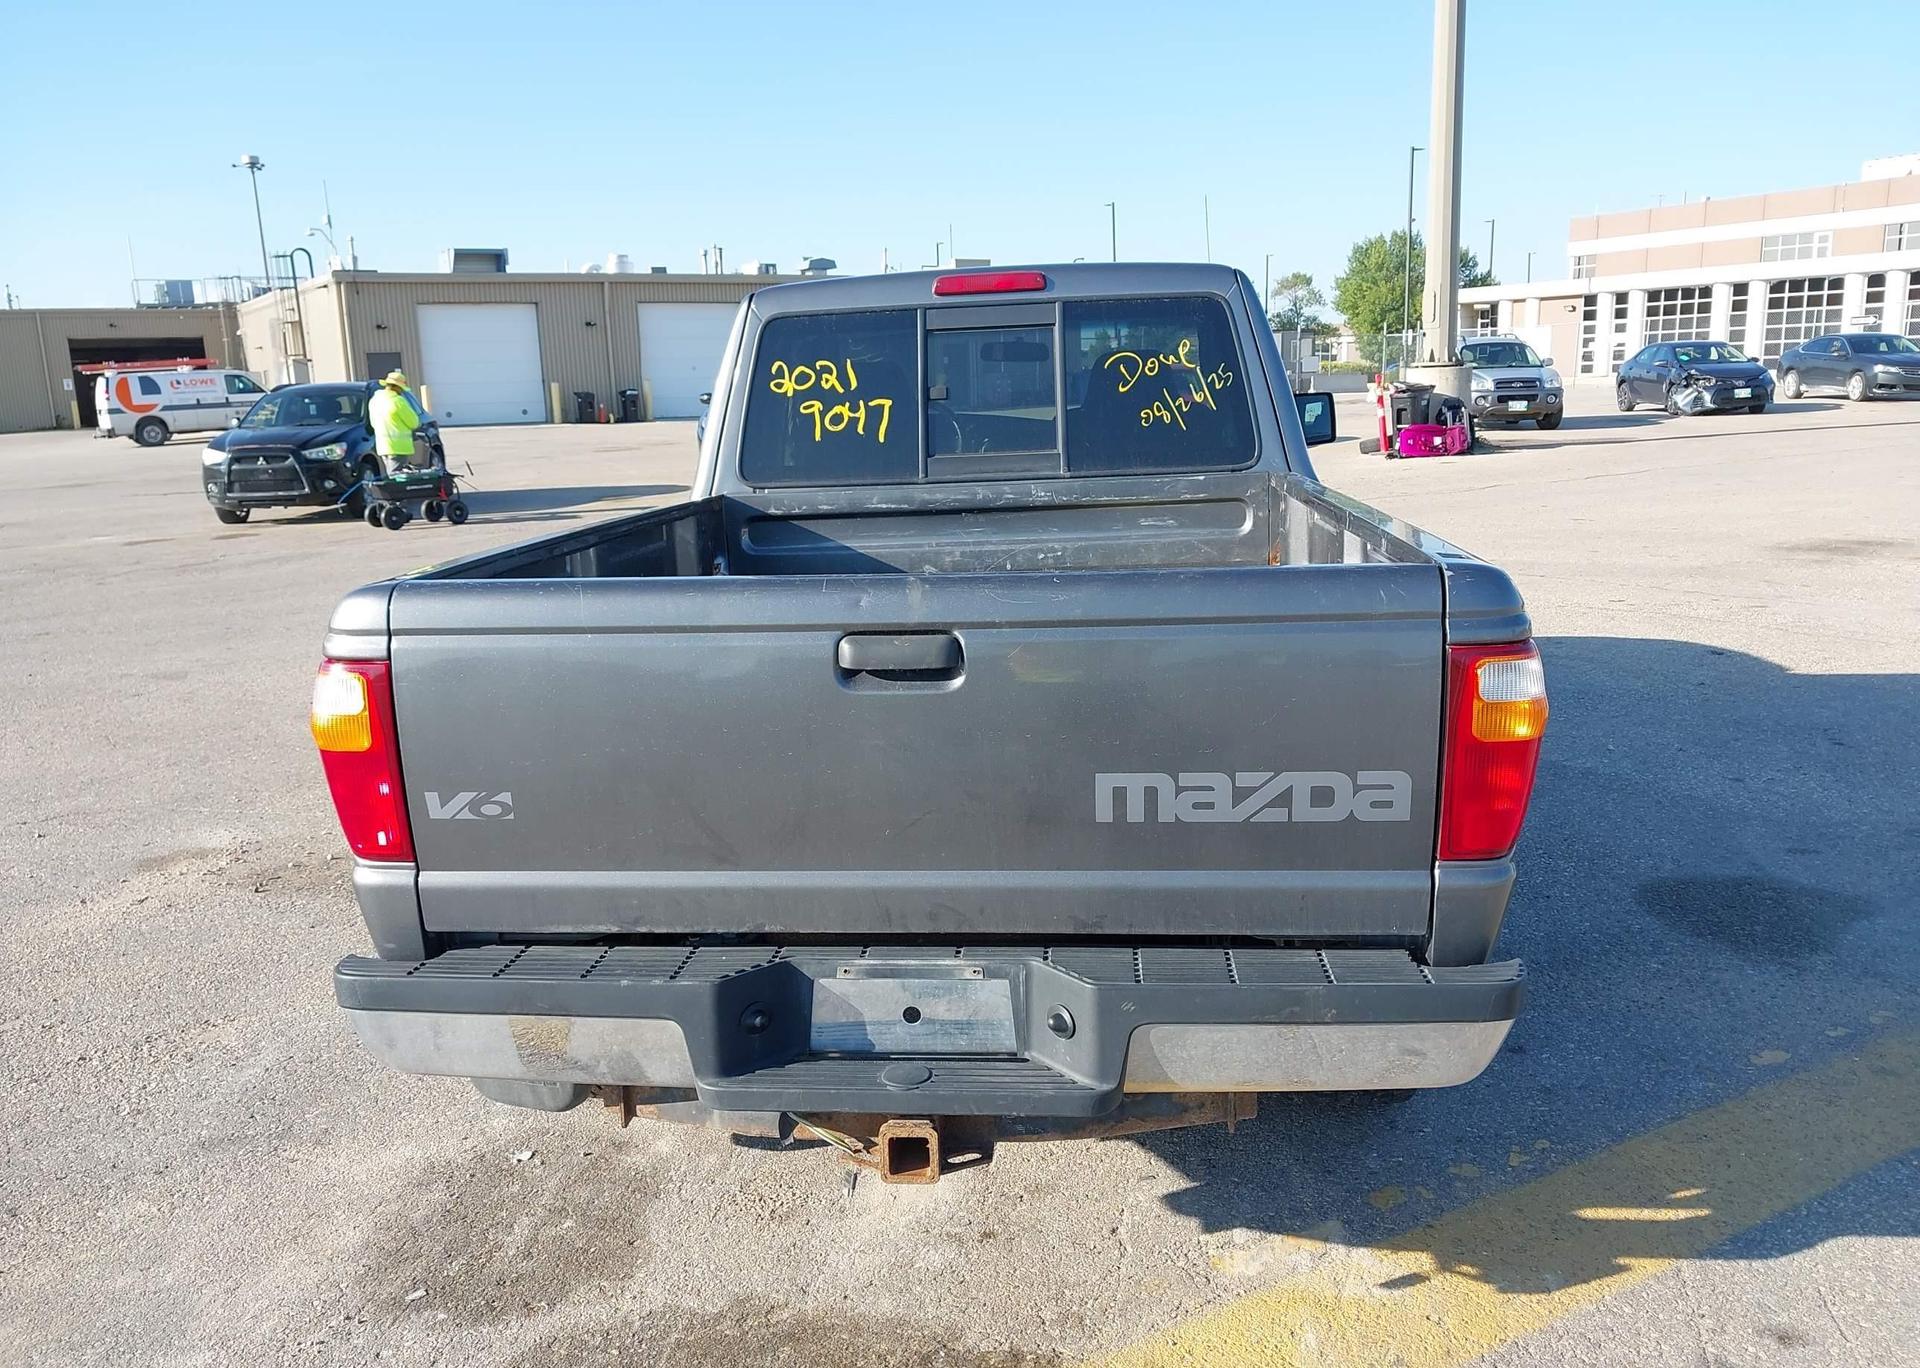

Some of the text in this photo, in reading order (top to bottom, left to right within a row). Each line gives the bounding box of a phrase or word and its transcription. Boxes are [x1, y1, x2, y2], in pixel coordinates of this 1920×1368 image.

[183, 377, 217, 386] LOWE
[769, 358, 858, 397] 2021
[1104, 339, 1196, 392] Done
[799, 398, 893, 443] 9047
[424, 792, 514, 819] V6
